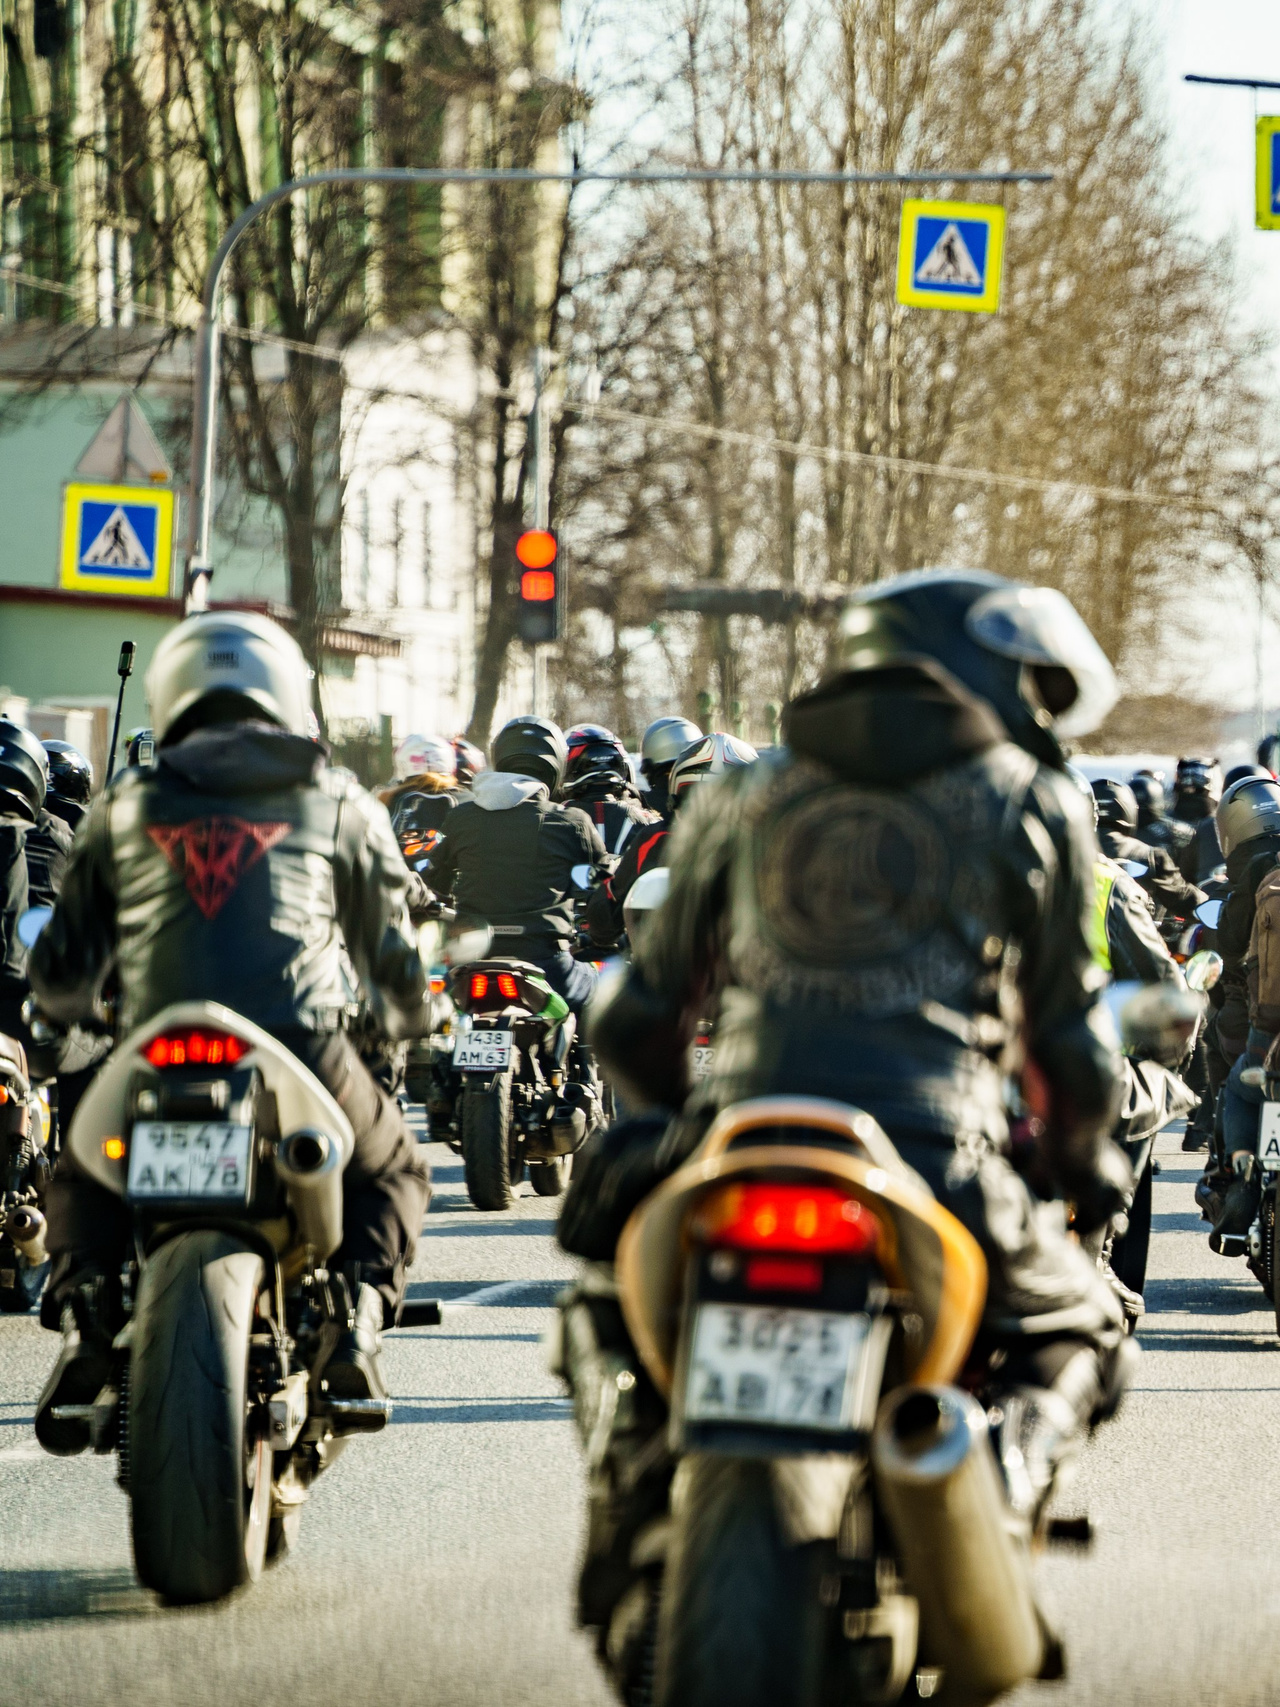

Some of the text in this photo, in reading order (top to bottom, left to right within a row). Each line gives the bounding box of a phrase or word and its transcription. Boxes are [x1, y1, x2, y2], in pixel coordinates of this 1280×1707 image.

[464, 1032, 503, 1045] 1438
[485, 1052, 505, 1064] 63
[148, 1125, 235, 1152] 9547
[203, 1163, 239, 1187] 78
